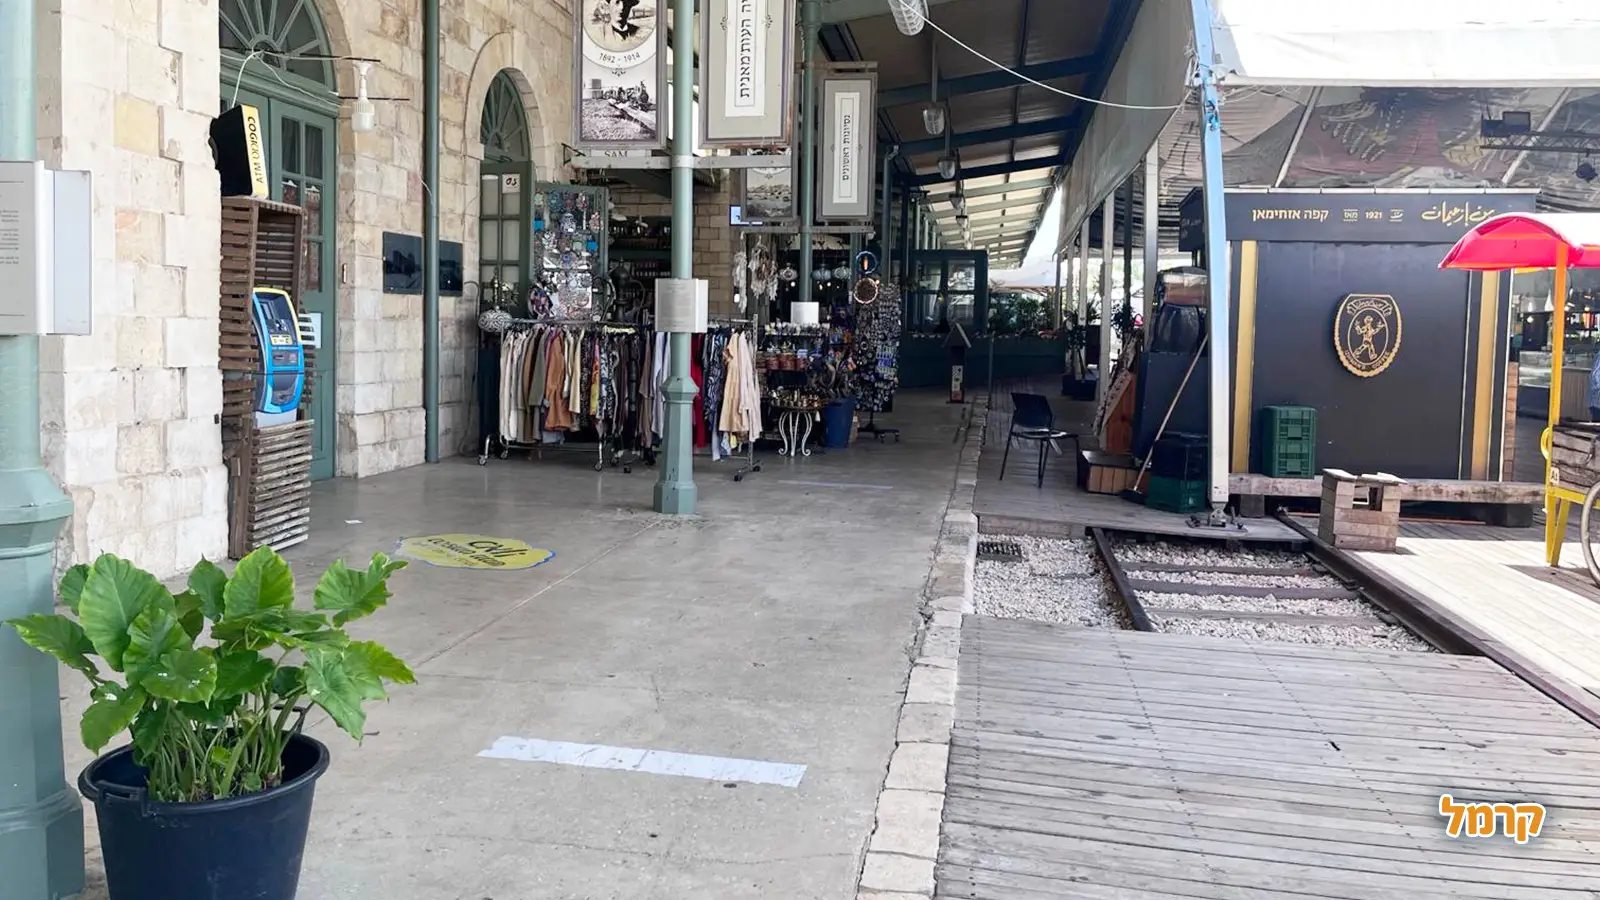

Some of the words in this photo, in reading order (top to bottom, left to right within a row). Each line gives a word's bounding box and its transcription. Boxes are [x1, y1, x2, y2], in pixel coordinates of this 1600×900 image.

[599, 52, 616, 63] 1892
[623, 52, 641, 63] 1914
[254, 162, 264, 184] ATM
[1252, 208, 1301, 222] אזחימאן
[1303, 208, 1330, 222] קפה
[1364, 211, 1383, 219] 1921
